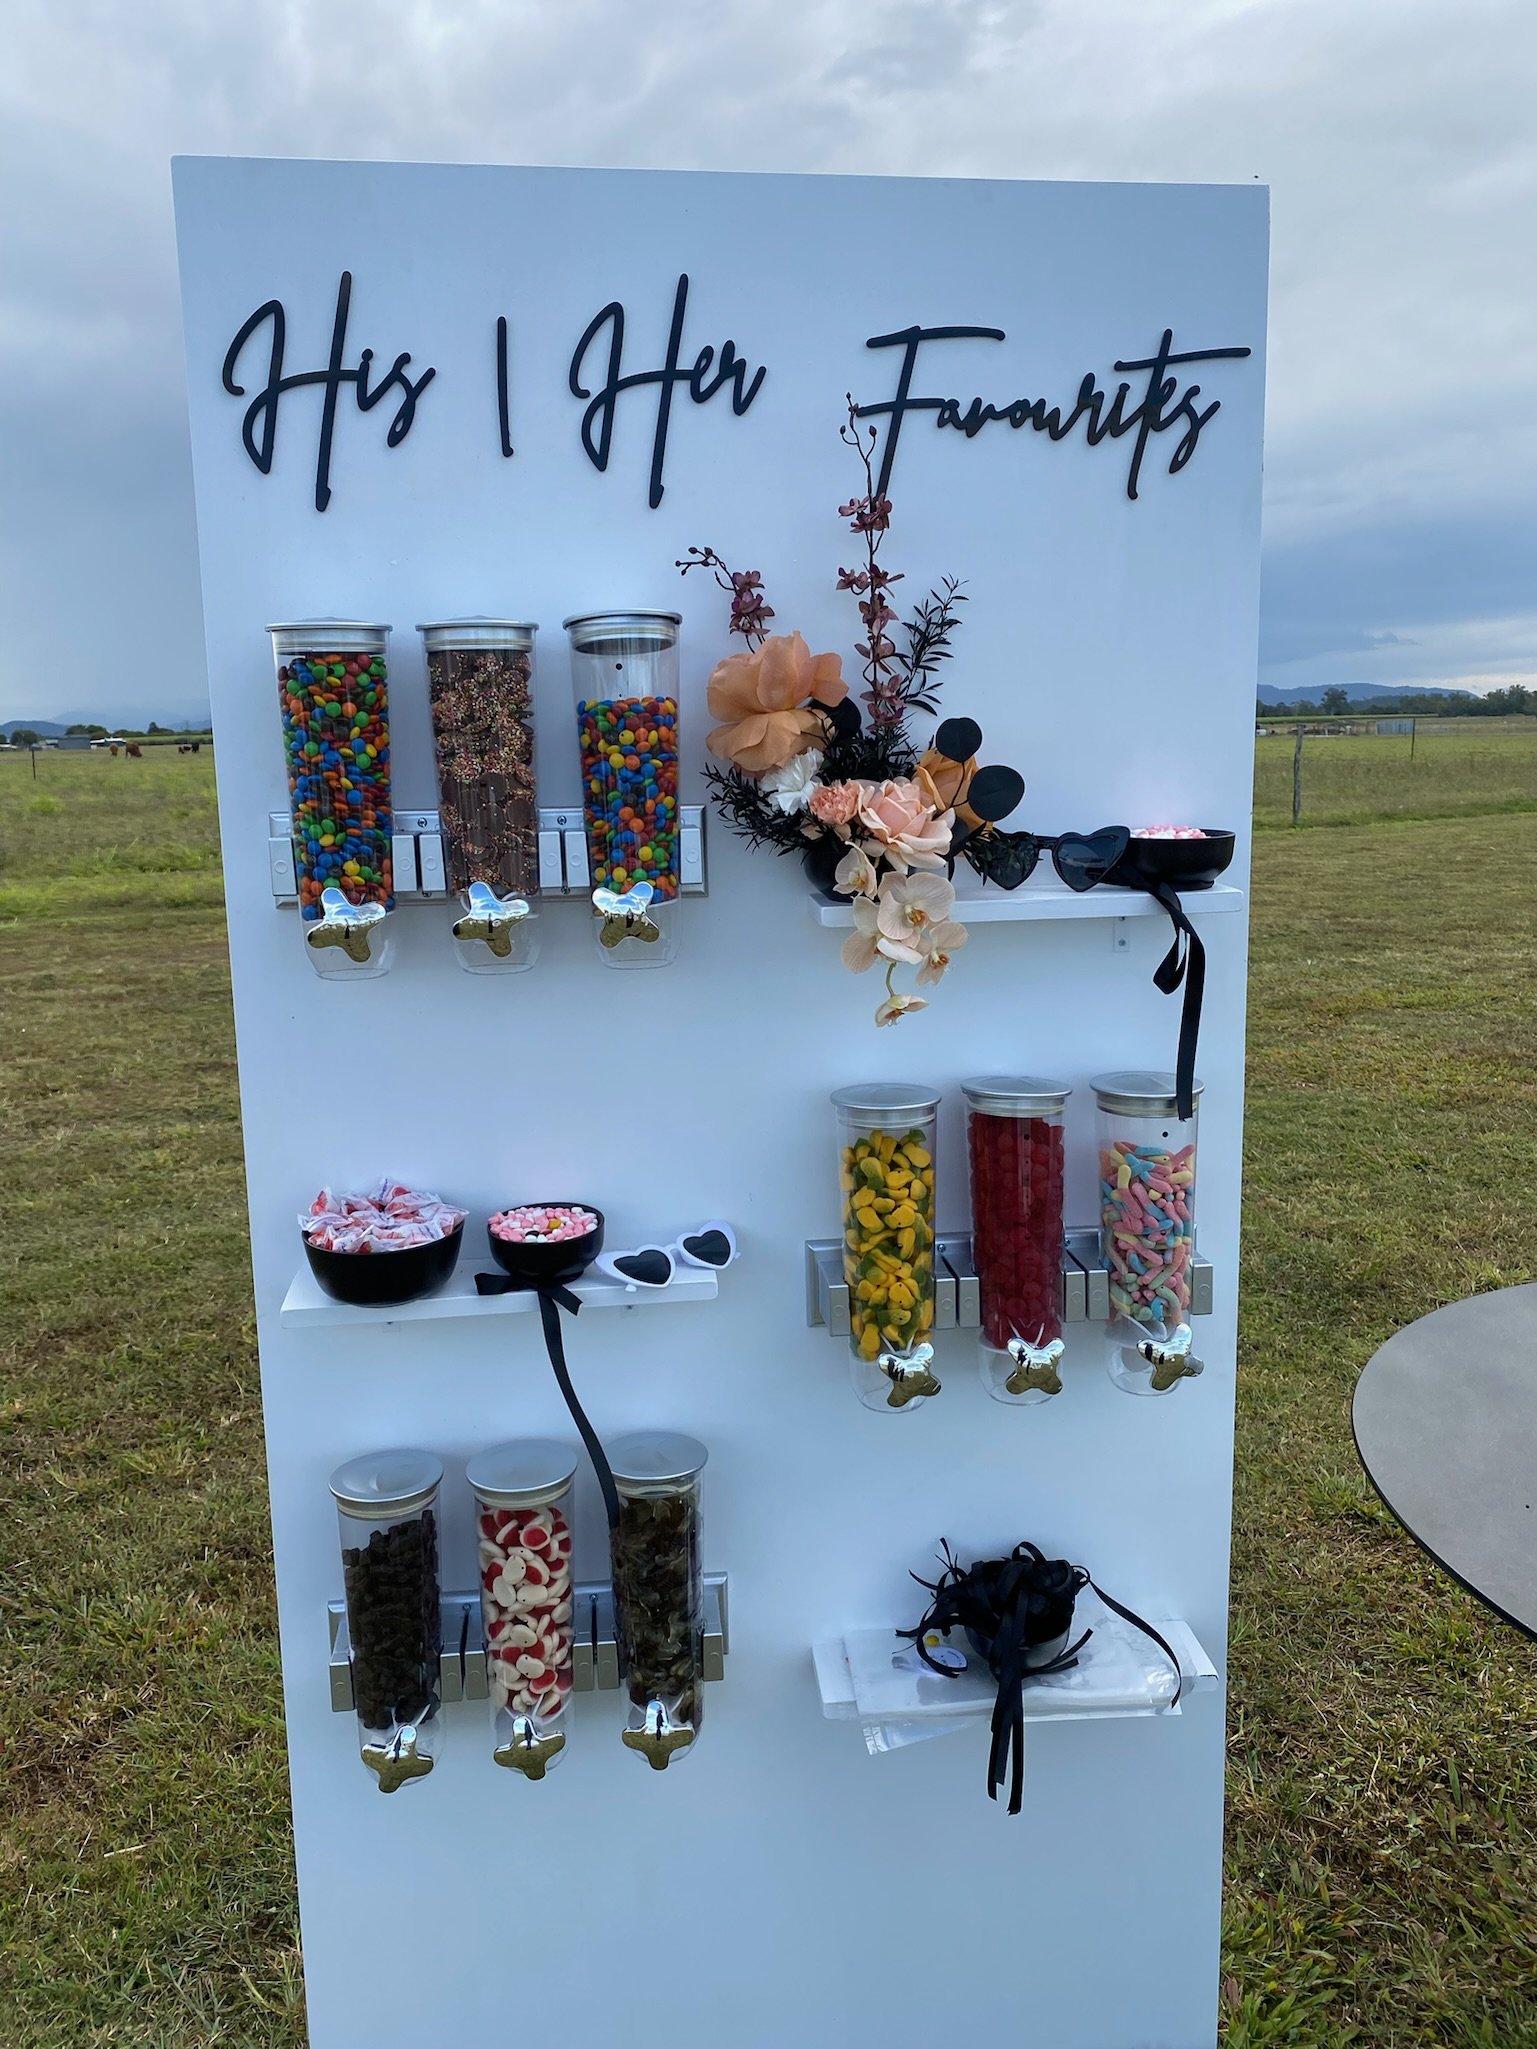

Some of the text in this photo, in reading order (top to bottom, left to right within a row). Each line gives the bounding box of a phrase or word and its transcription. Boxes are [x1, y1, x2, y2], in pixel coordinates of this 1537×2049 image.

[222, 271, 436, 512] His
[569, 274, 767, 509] Her
[856, 326, 1251, 502] Favourites
